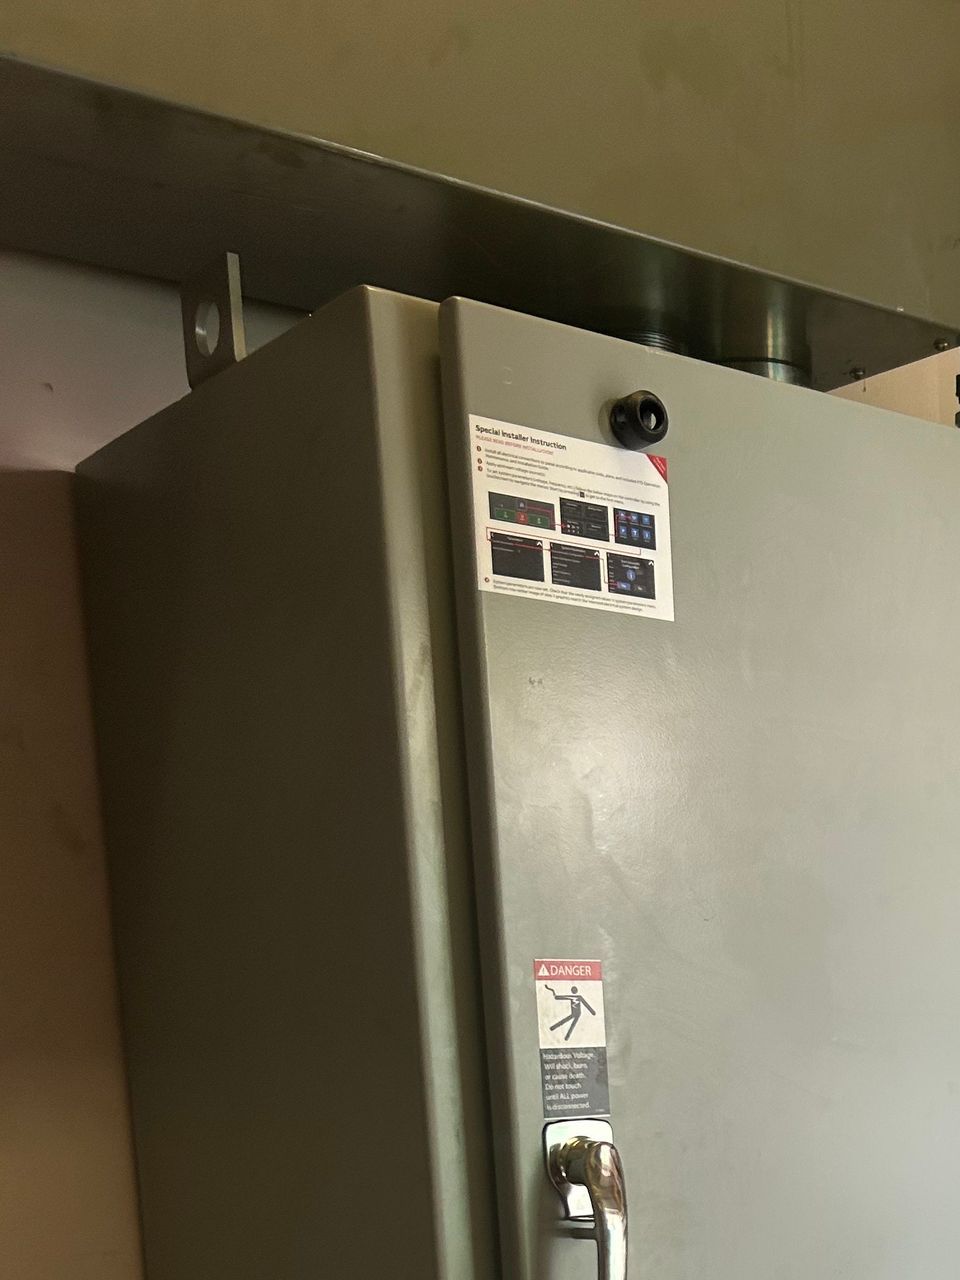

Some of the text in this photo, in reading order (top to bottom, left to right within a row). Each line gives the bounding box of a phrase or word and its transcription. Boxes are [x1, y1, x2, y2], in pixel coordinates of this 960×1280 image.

[475, 424, 567, 450] Special Installer Instruction
[550, 965, 592, 977] DANGER
[565, 1082, 582, 1090] touch
